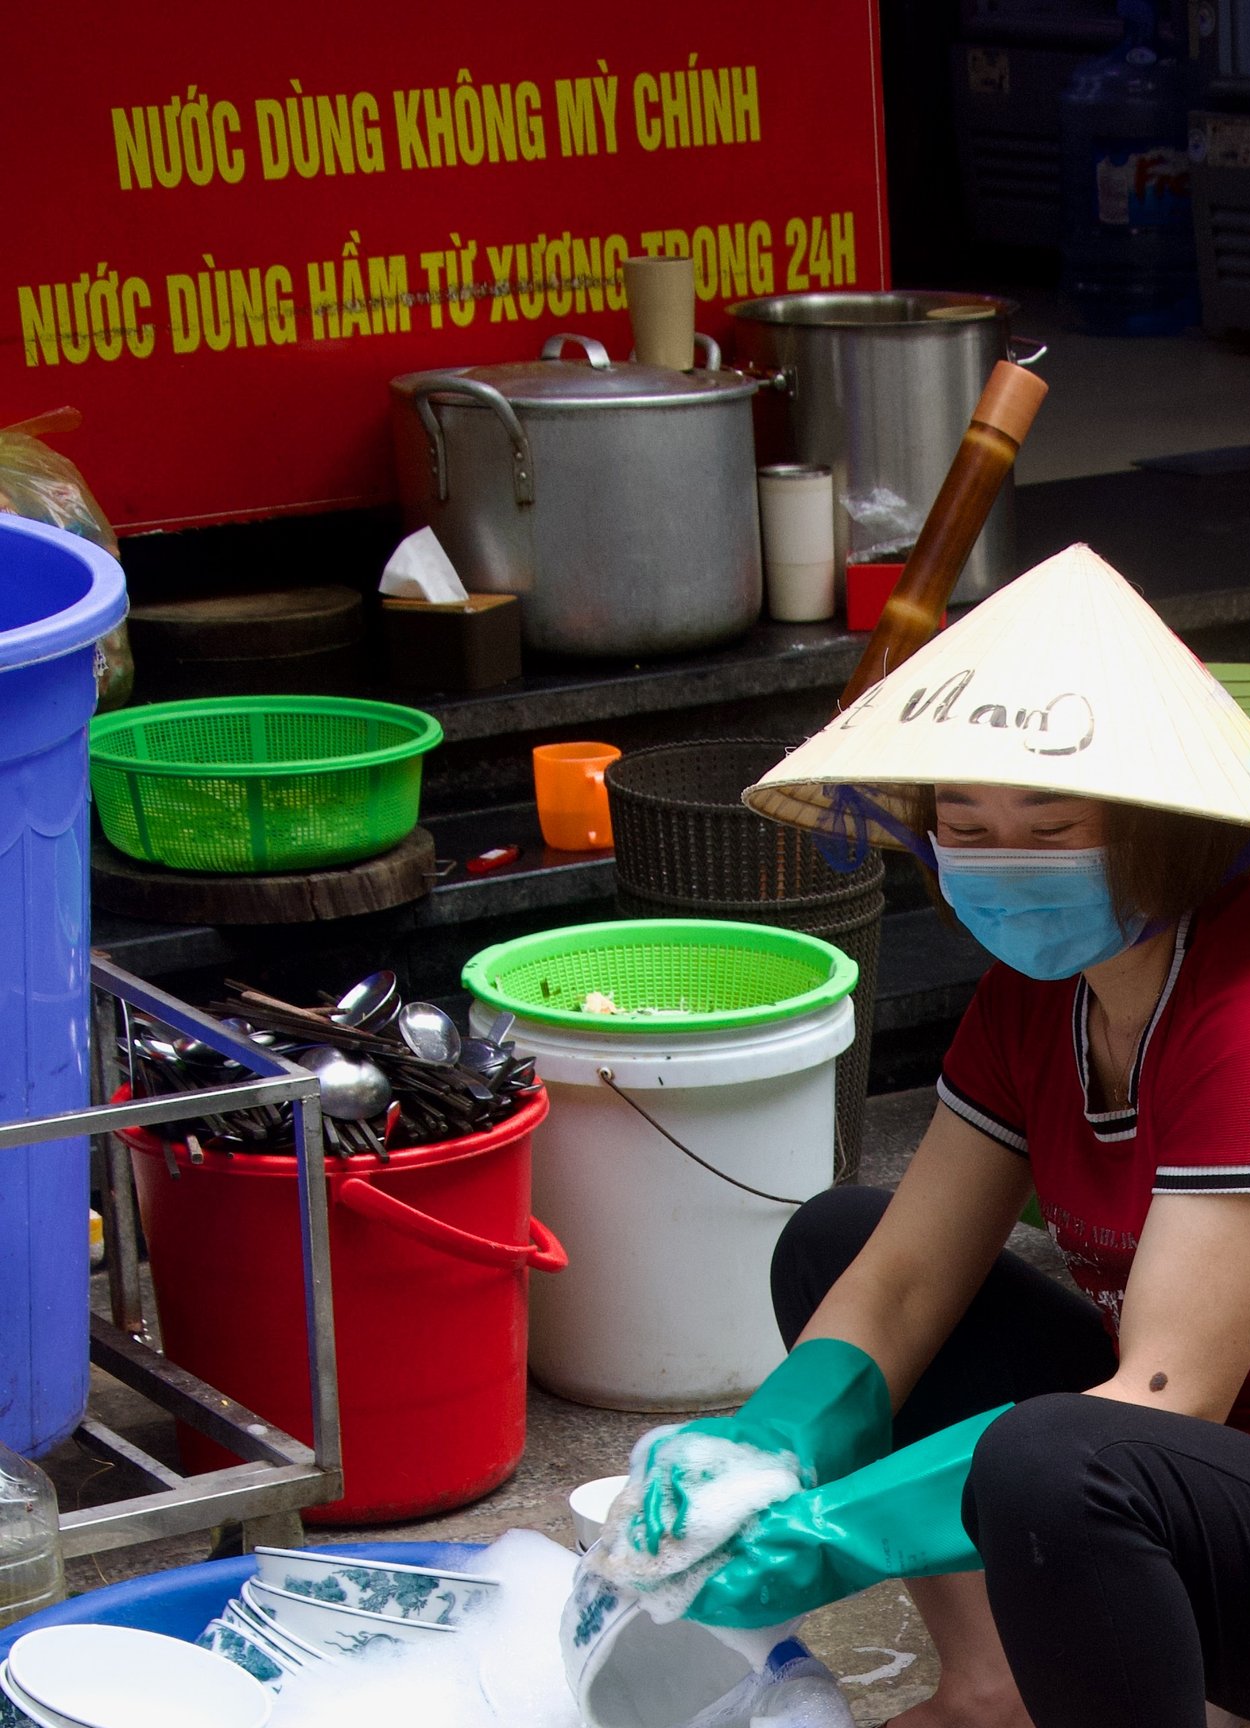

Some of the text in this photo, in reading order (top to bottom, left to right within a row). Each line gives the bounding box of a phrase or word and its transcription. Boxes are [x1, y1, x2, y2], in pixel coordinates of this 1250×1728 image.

[111, 52, 761, 190] NƯỚC DÙNG KHÔNG MỲ CHÍNH
[17, 261, 155, 367] NƯỚC
[166, 253, 297, 354] DÙNG
[307, 230, 411, 340] HẦM
[420, 232, 478, 329] TỪ
[486, 231, 630, 323] XƯƠNG
[785, 211, 857, 292] 24H
